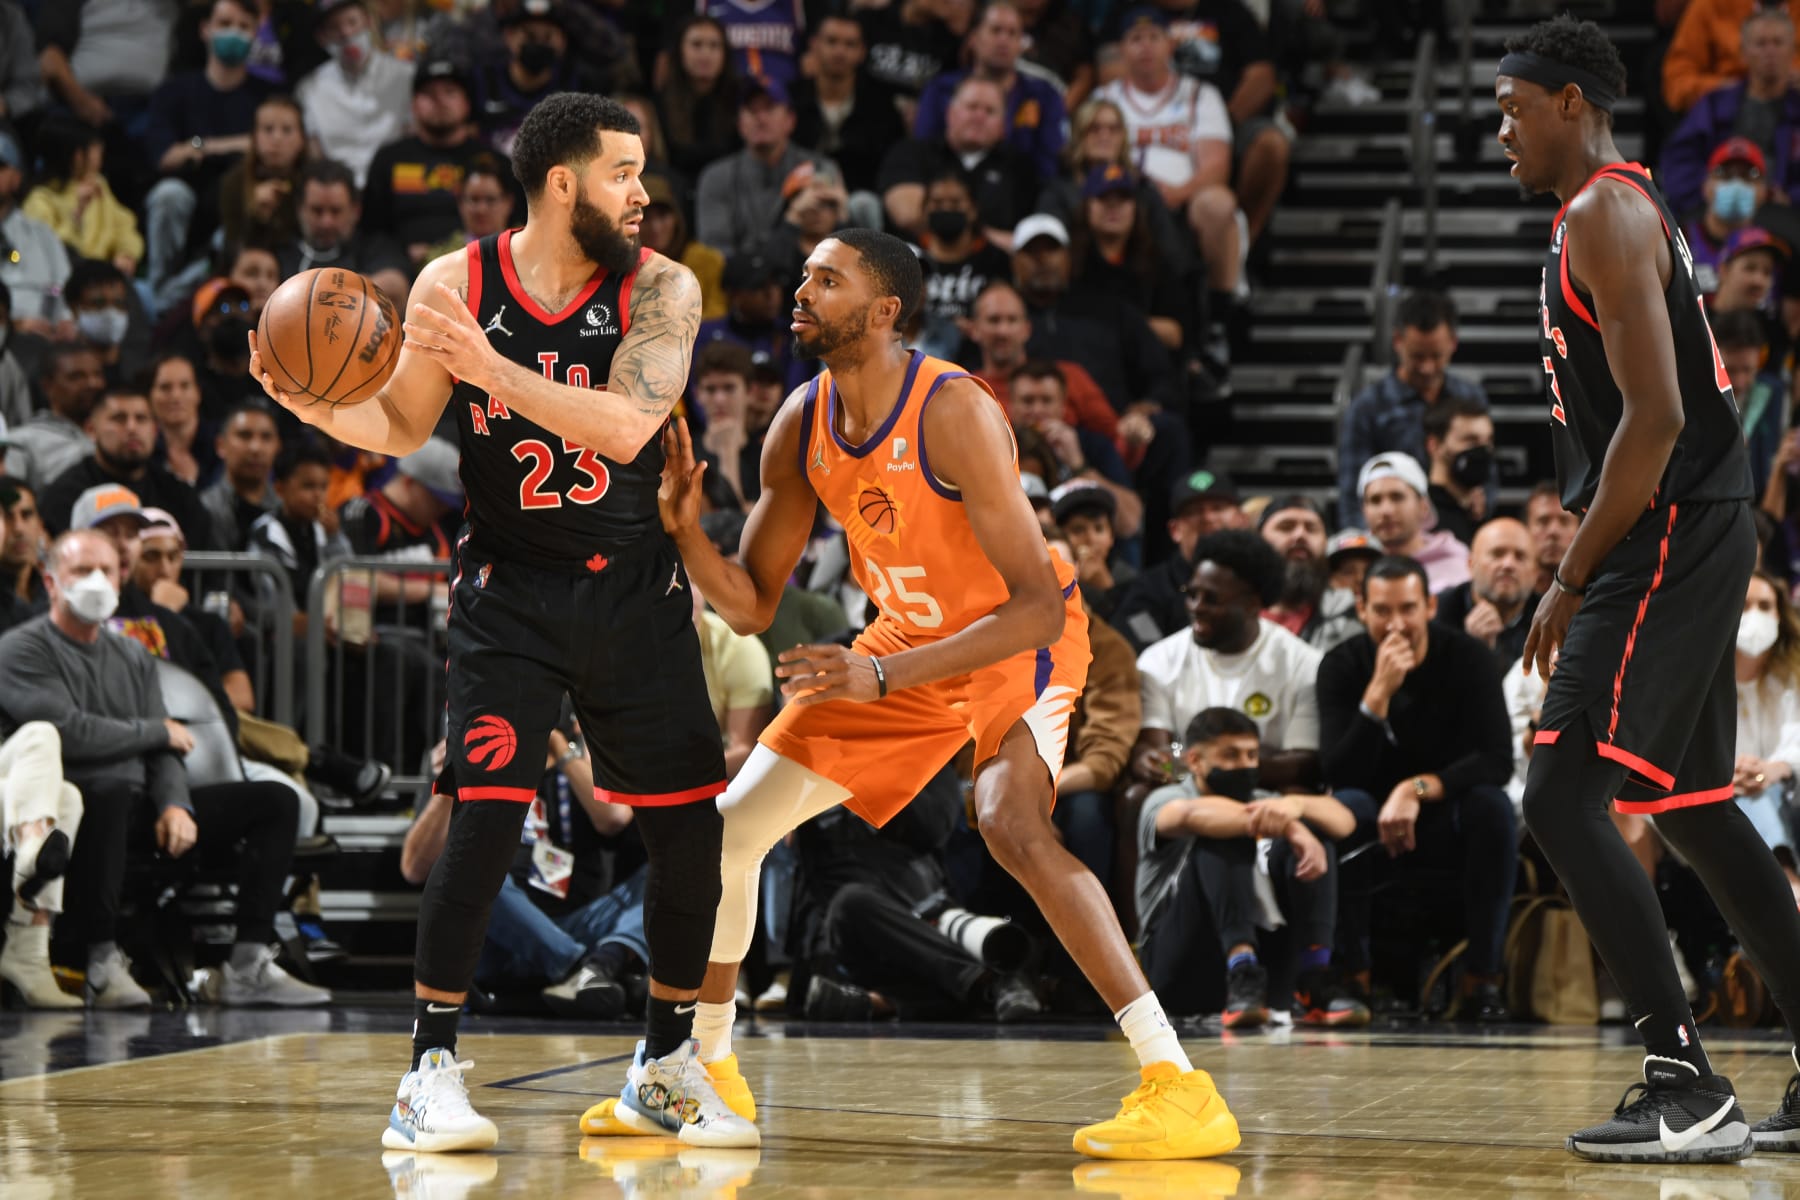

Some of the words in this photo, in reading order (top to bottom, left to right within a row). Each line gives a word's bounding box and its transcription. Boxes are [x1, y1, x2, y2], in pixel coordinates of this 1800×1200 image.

[579, 328, 599, 337] Sun
[600, 325, 618, 335] Life
[886, 461, 915, 472] PayPal
[511, 439, 610, 510] 23
